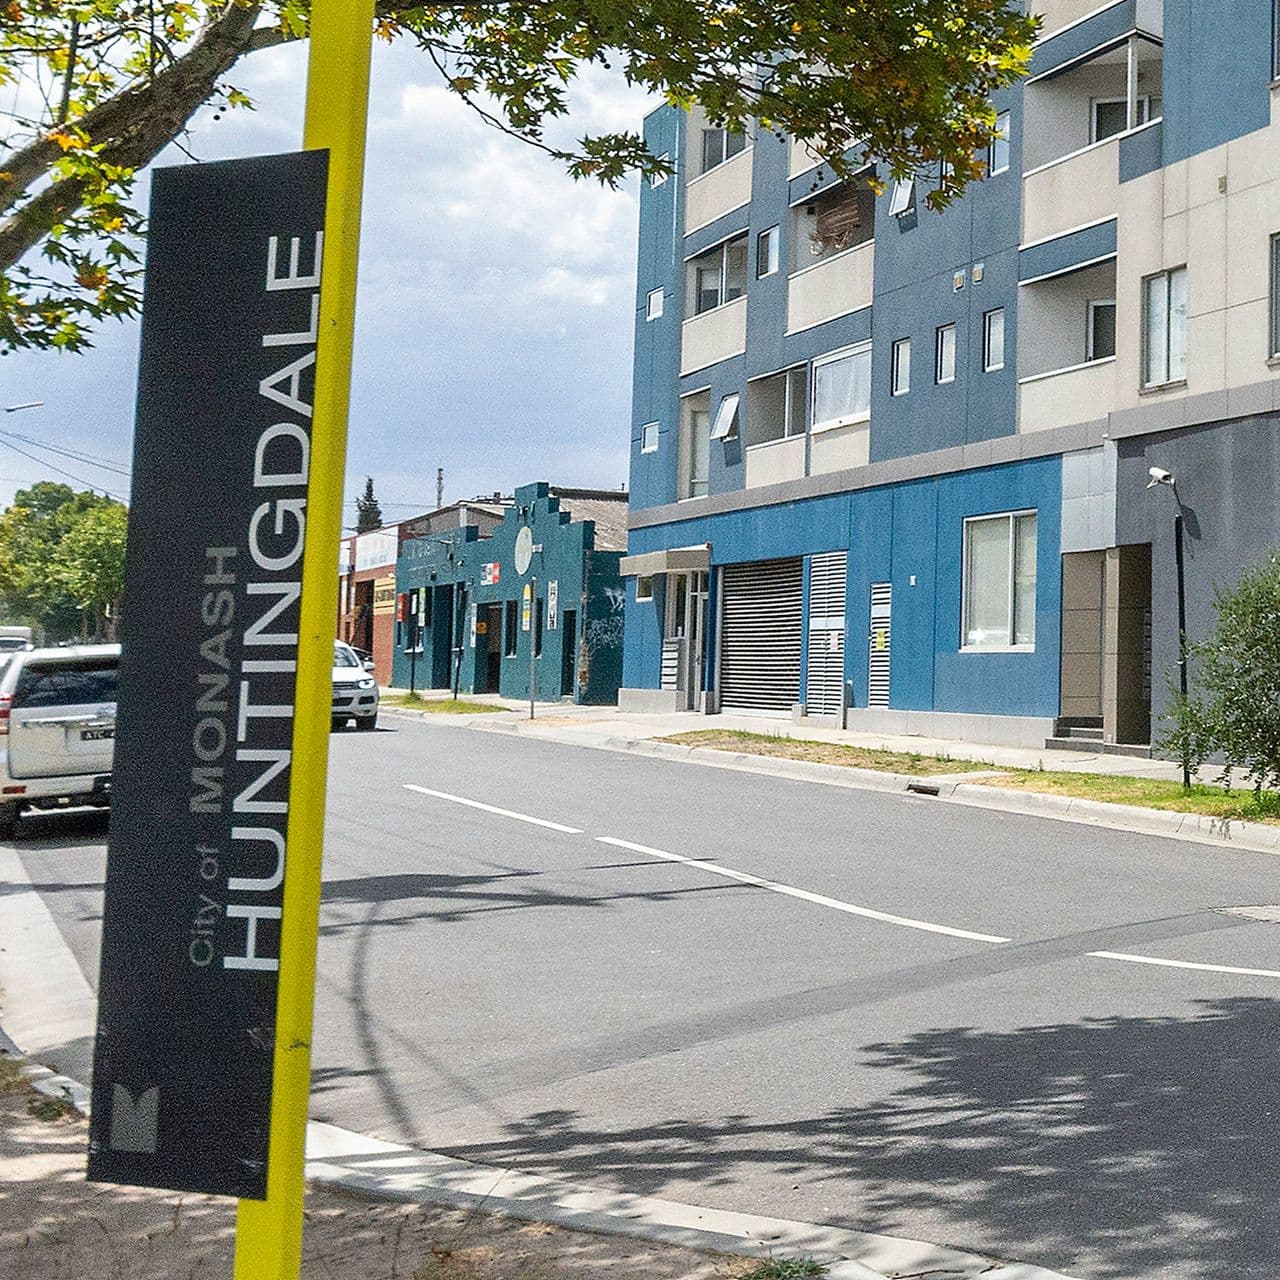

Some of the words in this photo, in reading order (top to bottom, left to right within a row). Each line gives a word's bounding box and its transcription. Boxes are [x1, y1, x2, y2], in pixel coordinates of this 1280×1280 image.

[189, 546, 238, 815] MONASH
[223, 230, 325, 973] HUNTINGDALE
[190, 891, 223, 968] City
[195, 843, 219, 881] of
